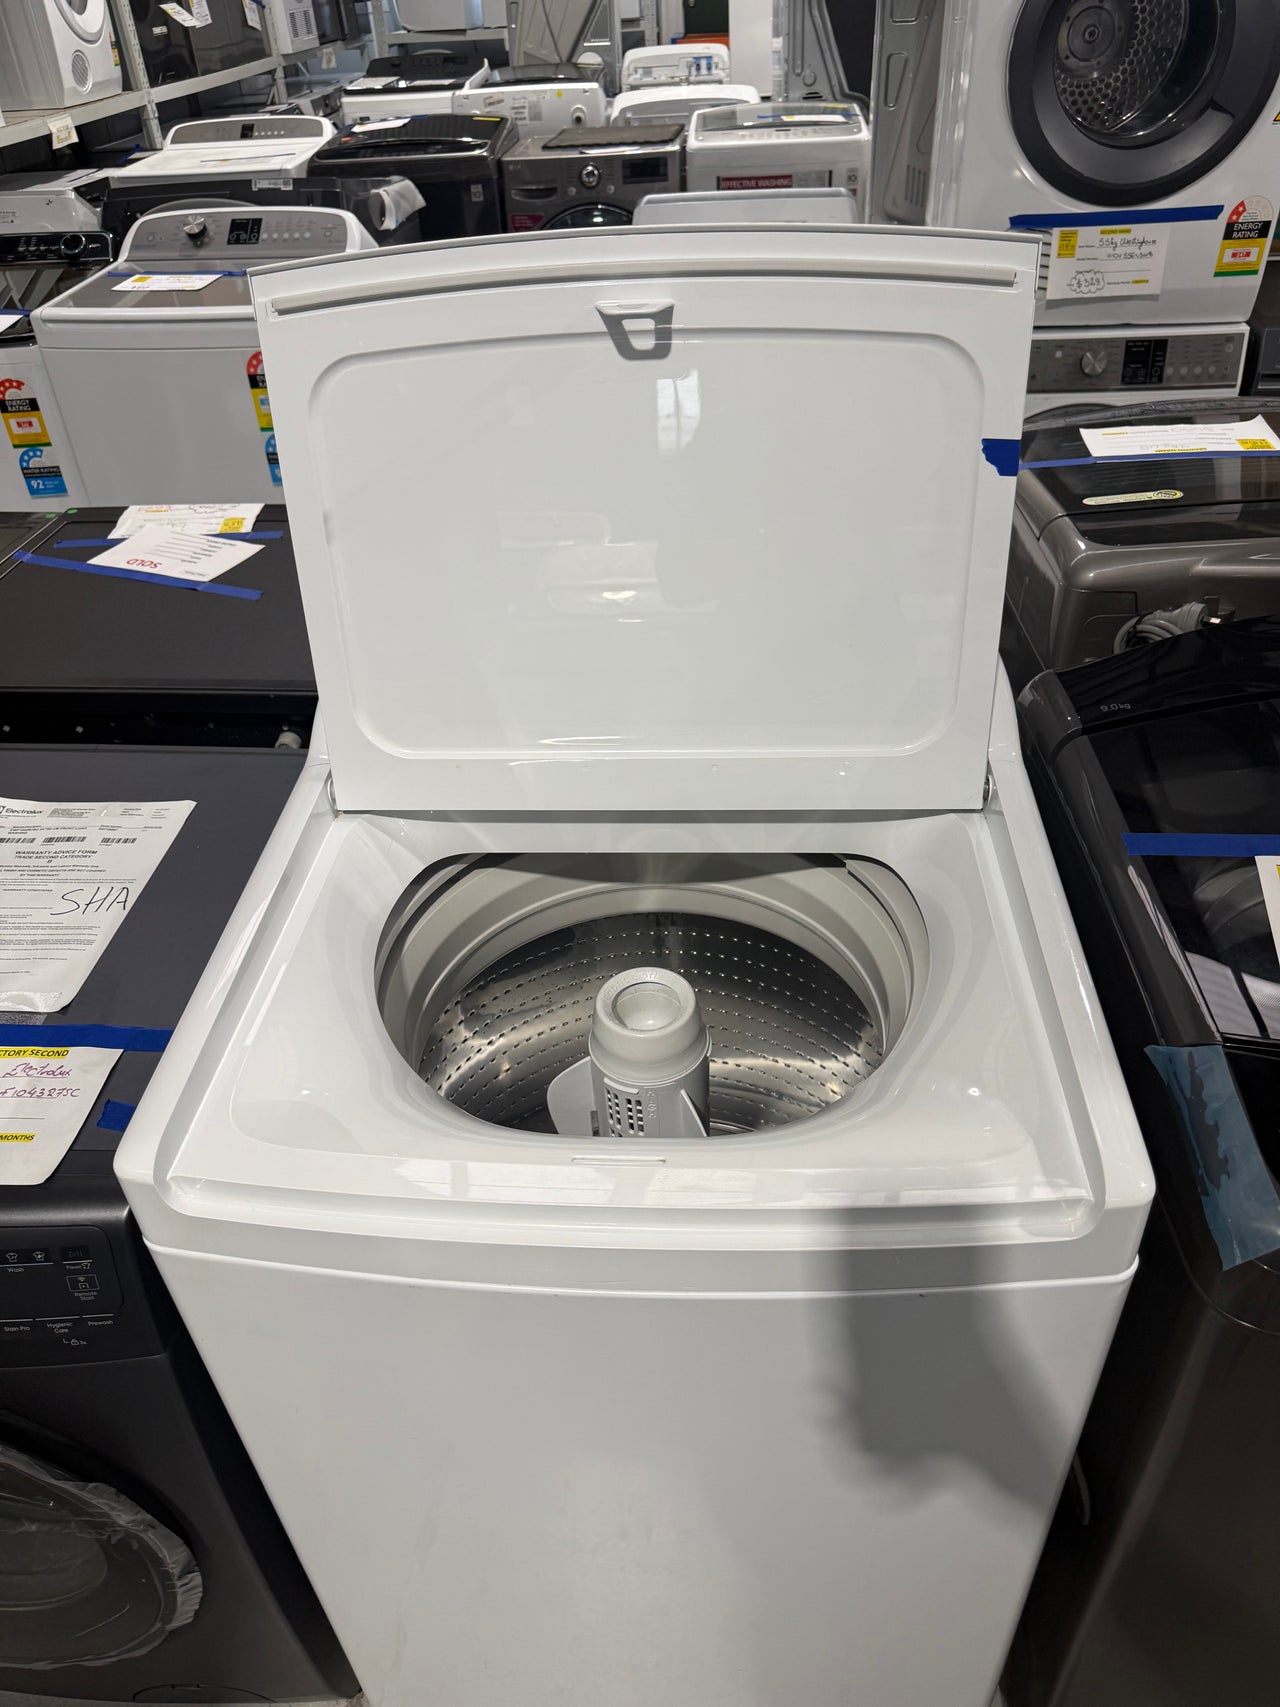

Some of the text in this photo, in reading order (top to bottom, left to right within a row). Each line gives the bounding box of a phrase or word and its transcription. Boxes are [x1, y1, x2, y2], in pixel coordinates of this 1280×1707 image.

[721, 178, 757, 189] EFFECTIVE
[757, 177, 793, 188] WASHING
[1233, 222, 1263, 231] ENERGY
[1231, 231, 1259, 239] RATING
[31, 479, 45, 489] 92
[126, 558, 162, 569] SOLD
[50, 886, 130, 916] SHA
[29, 1049, 70, 1057] SECOND
